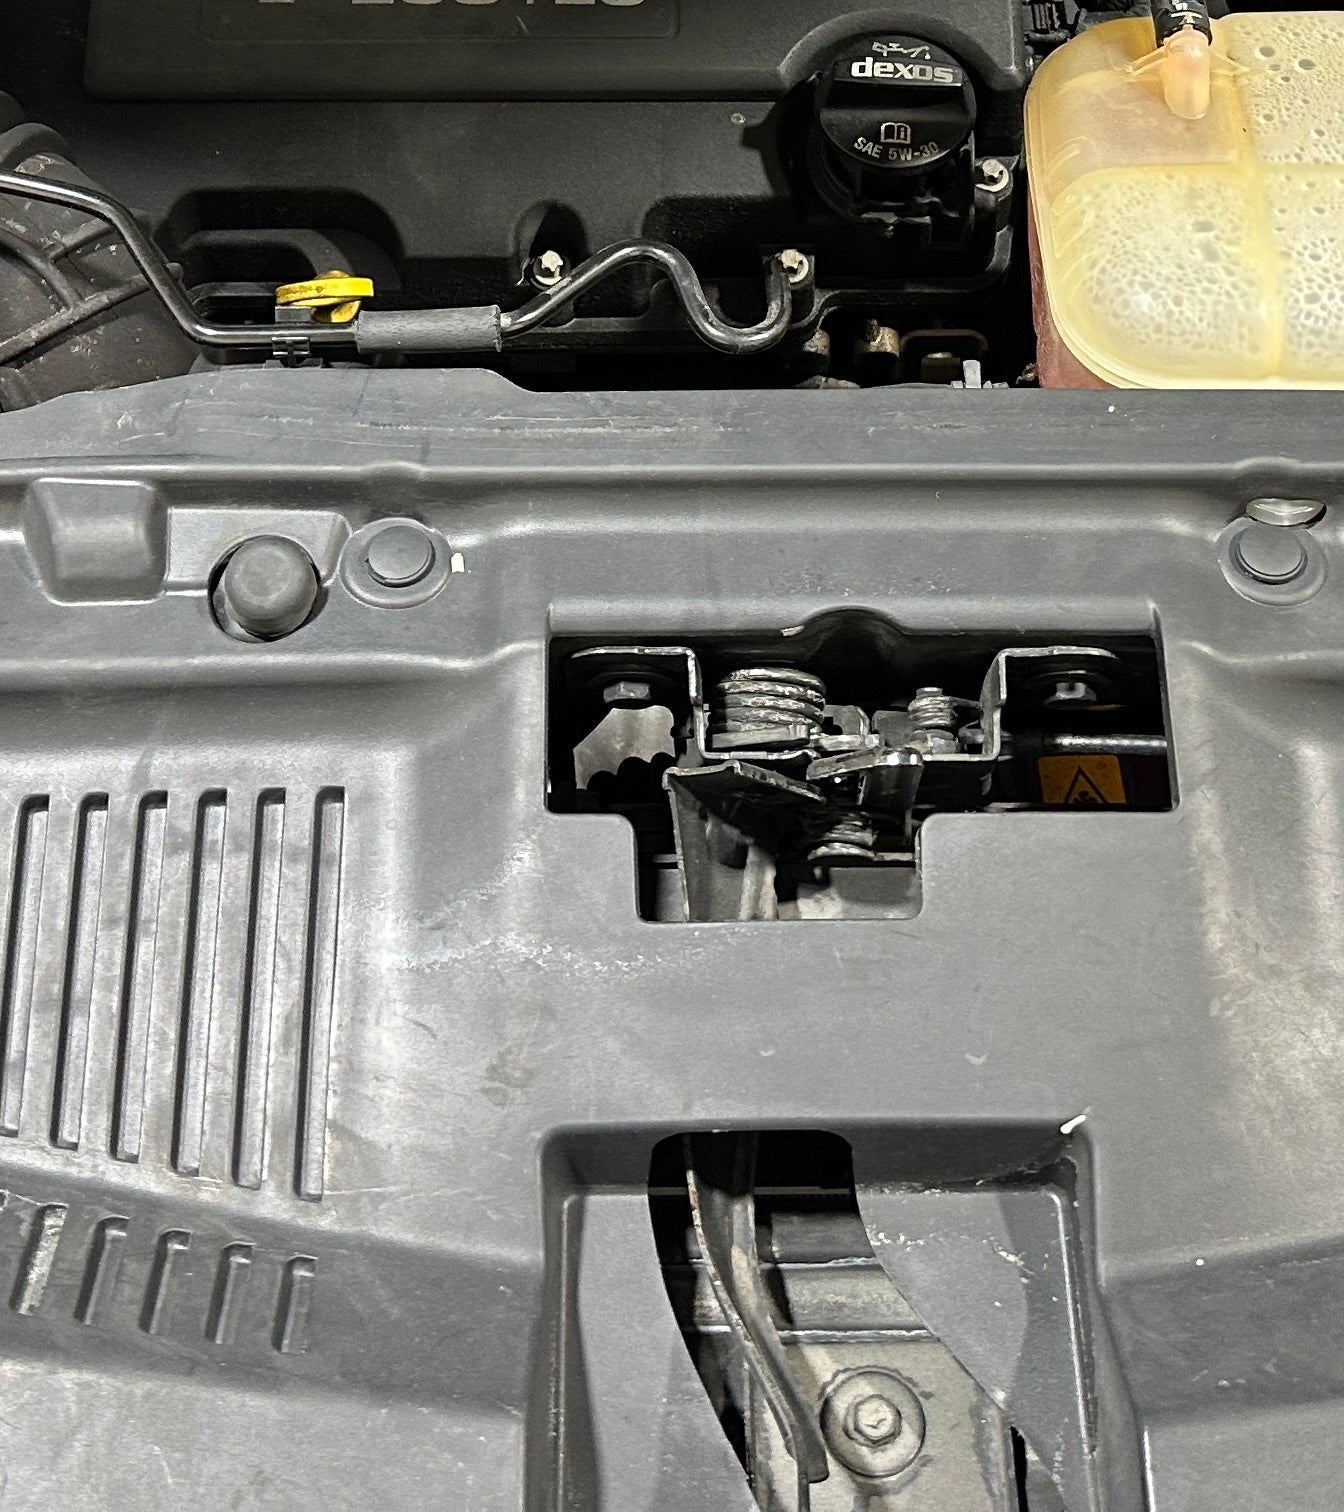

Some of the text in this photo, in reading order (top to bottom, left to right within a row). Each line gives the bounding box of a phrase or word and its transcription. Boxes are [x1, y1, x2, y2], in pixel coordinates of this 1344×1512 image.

[851, 56, 954, 83] dexos
[853, 137, 940, 161] SAE 5W-30
